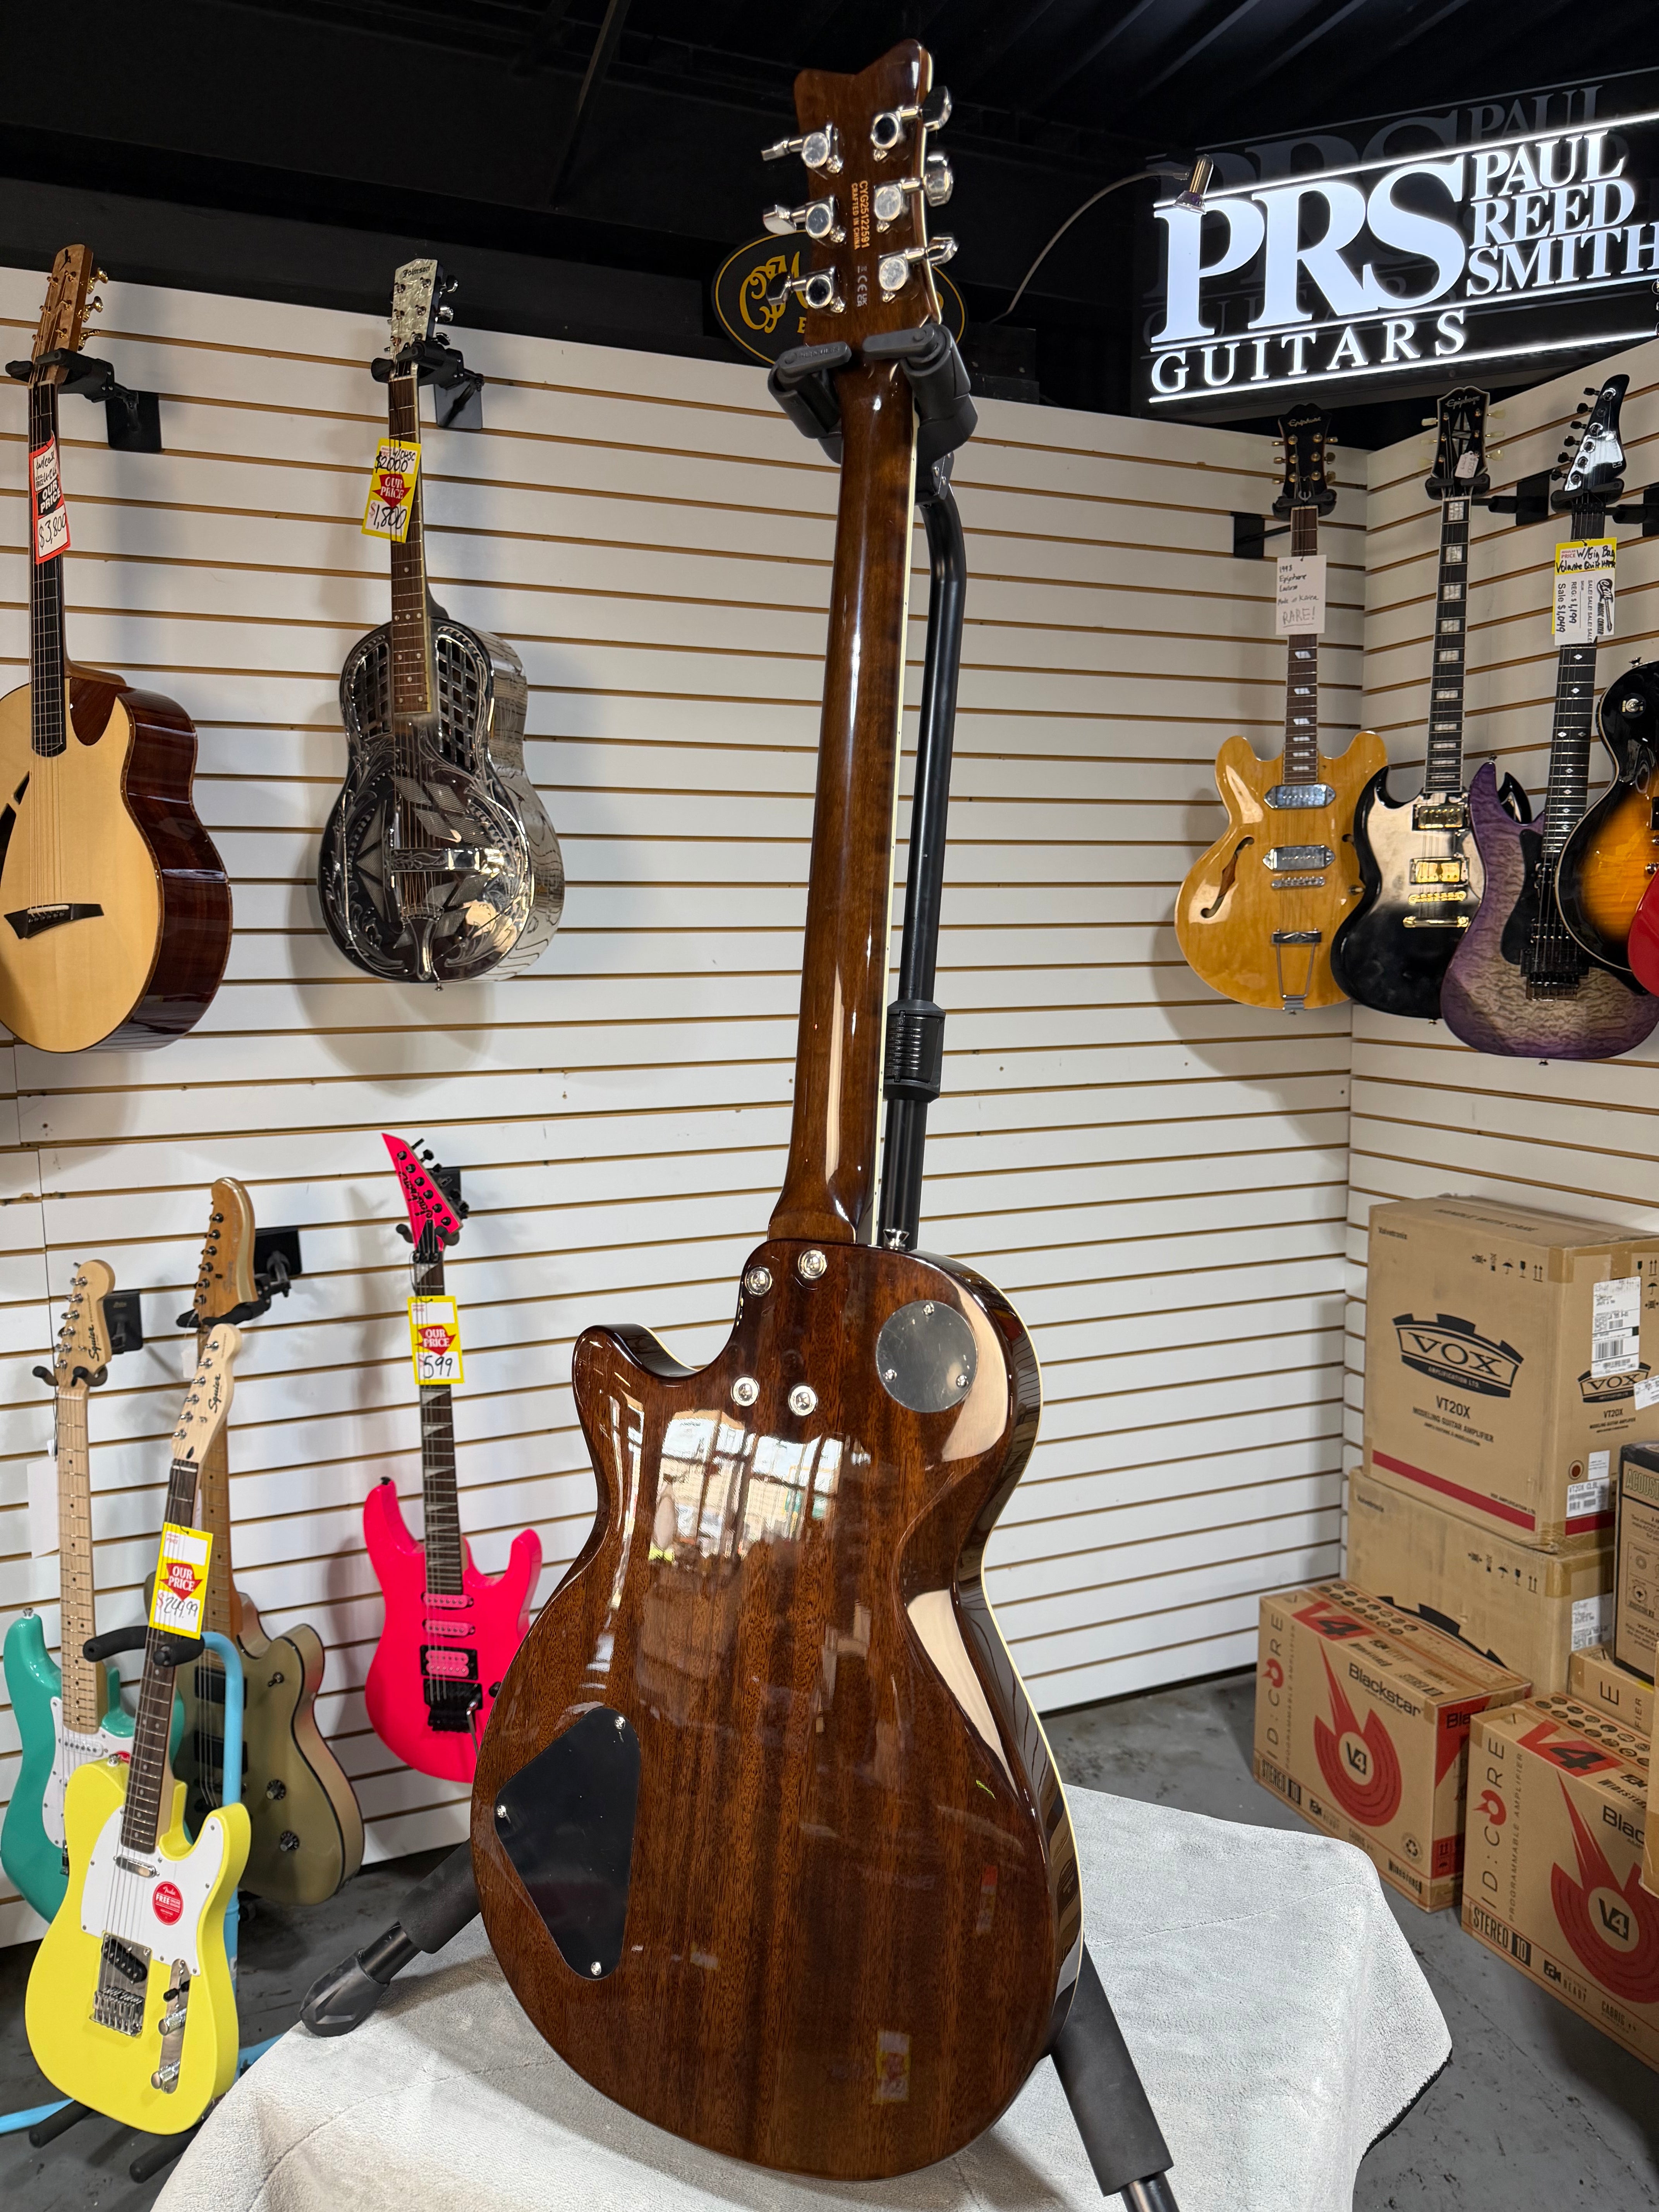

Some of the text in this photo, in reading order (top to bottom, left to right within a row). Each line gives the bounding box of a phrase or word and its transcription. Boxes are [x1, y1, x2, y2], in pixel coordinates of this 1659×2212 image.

[1471, 131, 1626, 202] PAUL
[853, 217, 859, 226] IN
[860, 180, 870, 249] CYG25122591
[1470, 179, 1635, 249] REED
[1151, 155, 1466, 343] PRS
[1466, 222, 1659, 297] SMITH
[402, 266, 430, 278] Johnson
[1150, 309, 1467, 394] GUITARS
[1445, 395, 1480, 410] Epiphone
[42, 480, 58, 500] OUR
[380, 486, 404, 500] PRICE
[385, 477, 403, 488] OUR
[41, 489, 60, 513] PRICE
[39, 513, 66, 550] $3,800
[1558, 583, 1566, 602] Sale
[1283, 606, 1315, 625] RARE!
[88, 1324, 101, 1362] Squier
[423, 1338, 450, 1347] PRICE
[425, 1329, 446, 1338] OUR
[1408, 1331, 1502, 1377] VOX
[208, 1373, 222, 1413] Squier
[1587, 1373, 1640, 1390] VOX
[1436, 1395, 1471, 1419] VT20X
[1603, 1408, 1623, 1418] VT20X
[168, 1577, 195, 1592] PRICE
[172, 1566, 193, 1580] OUR
[1349, 1662, 1422, 1716] Blackstar
[1345, 1741, 1366, 1775] V4
[1597, 1779, 1647, 1809] WIDESTER
[1602, 1805, 1644, 1845] Blac
[1509, 1823, 1519, 1923] PROGRAMMABLE
[156, 1893, 170, 1905] FREE
[1473, 1906, 1509, 1949] STEREO
[1599, 1897, 1629, 1941] V4
